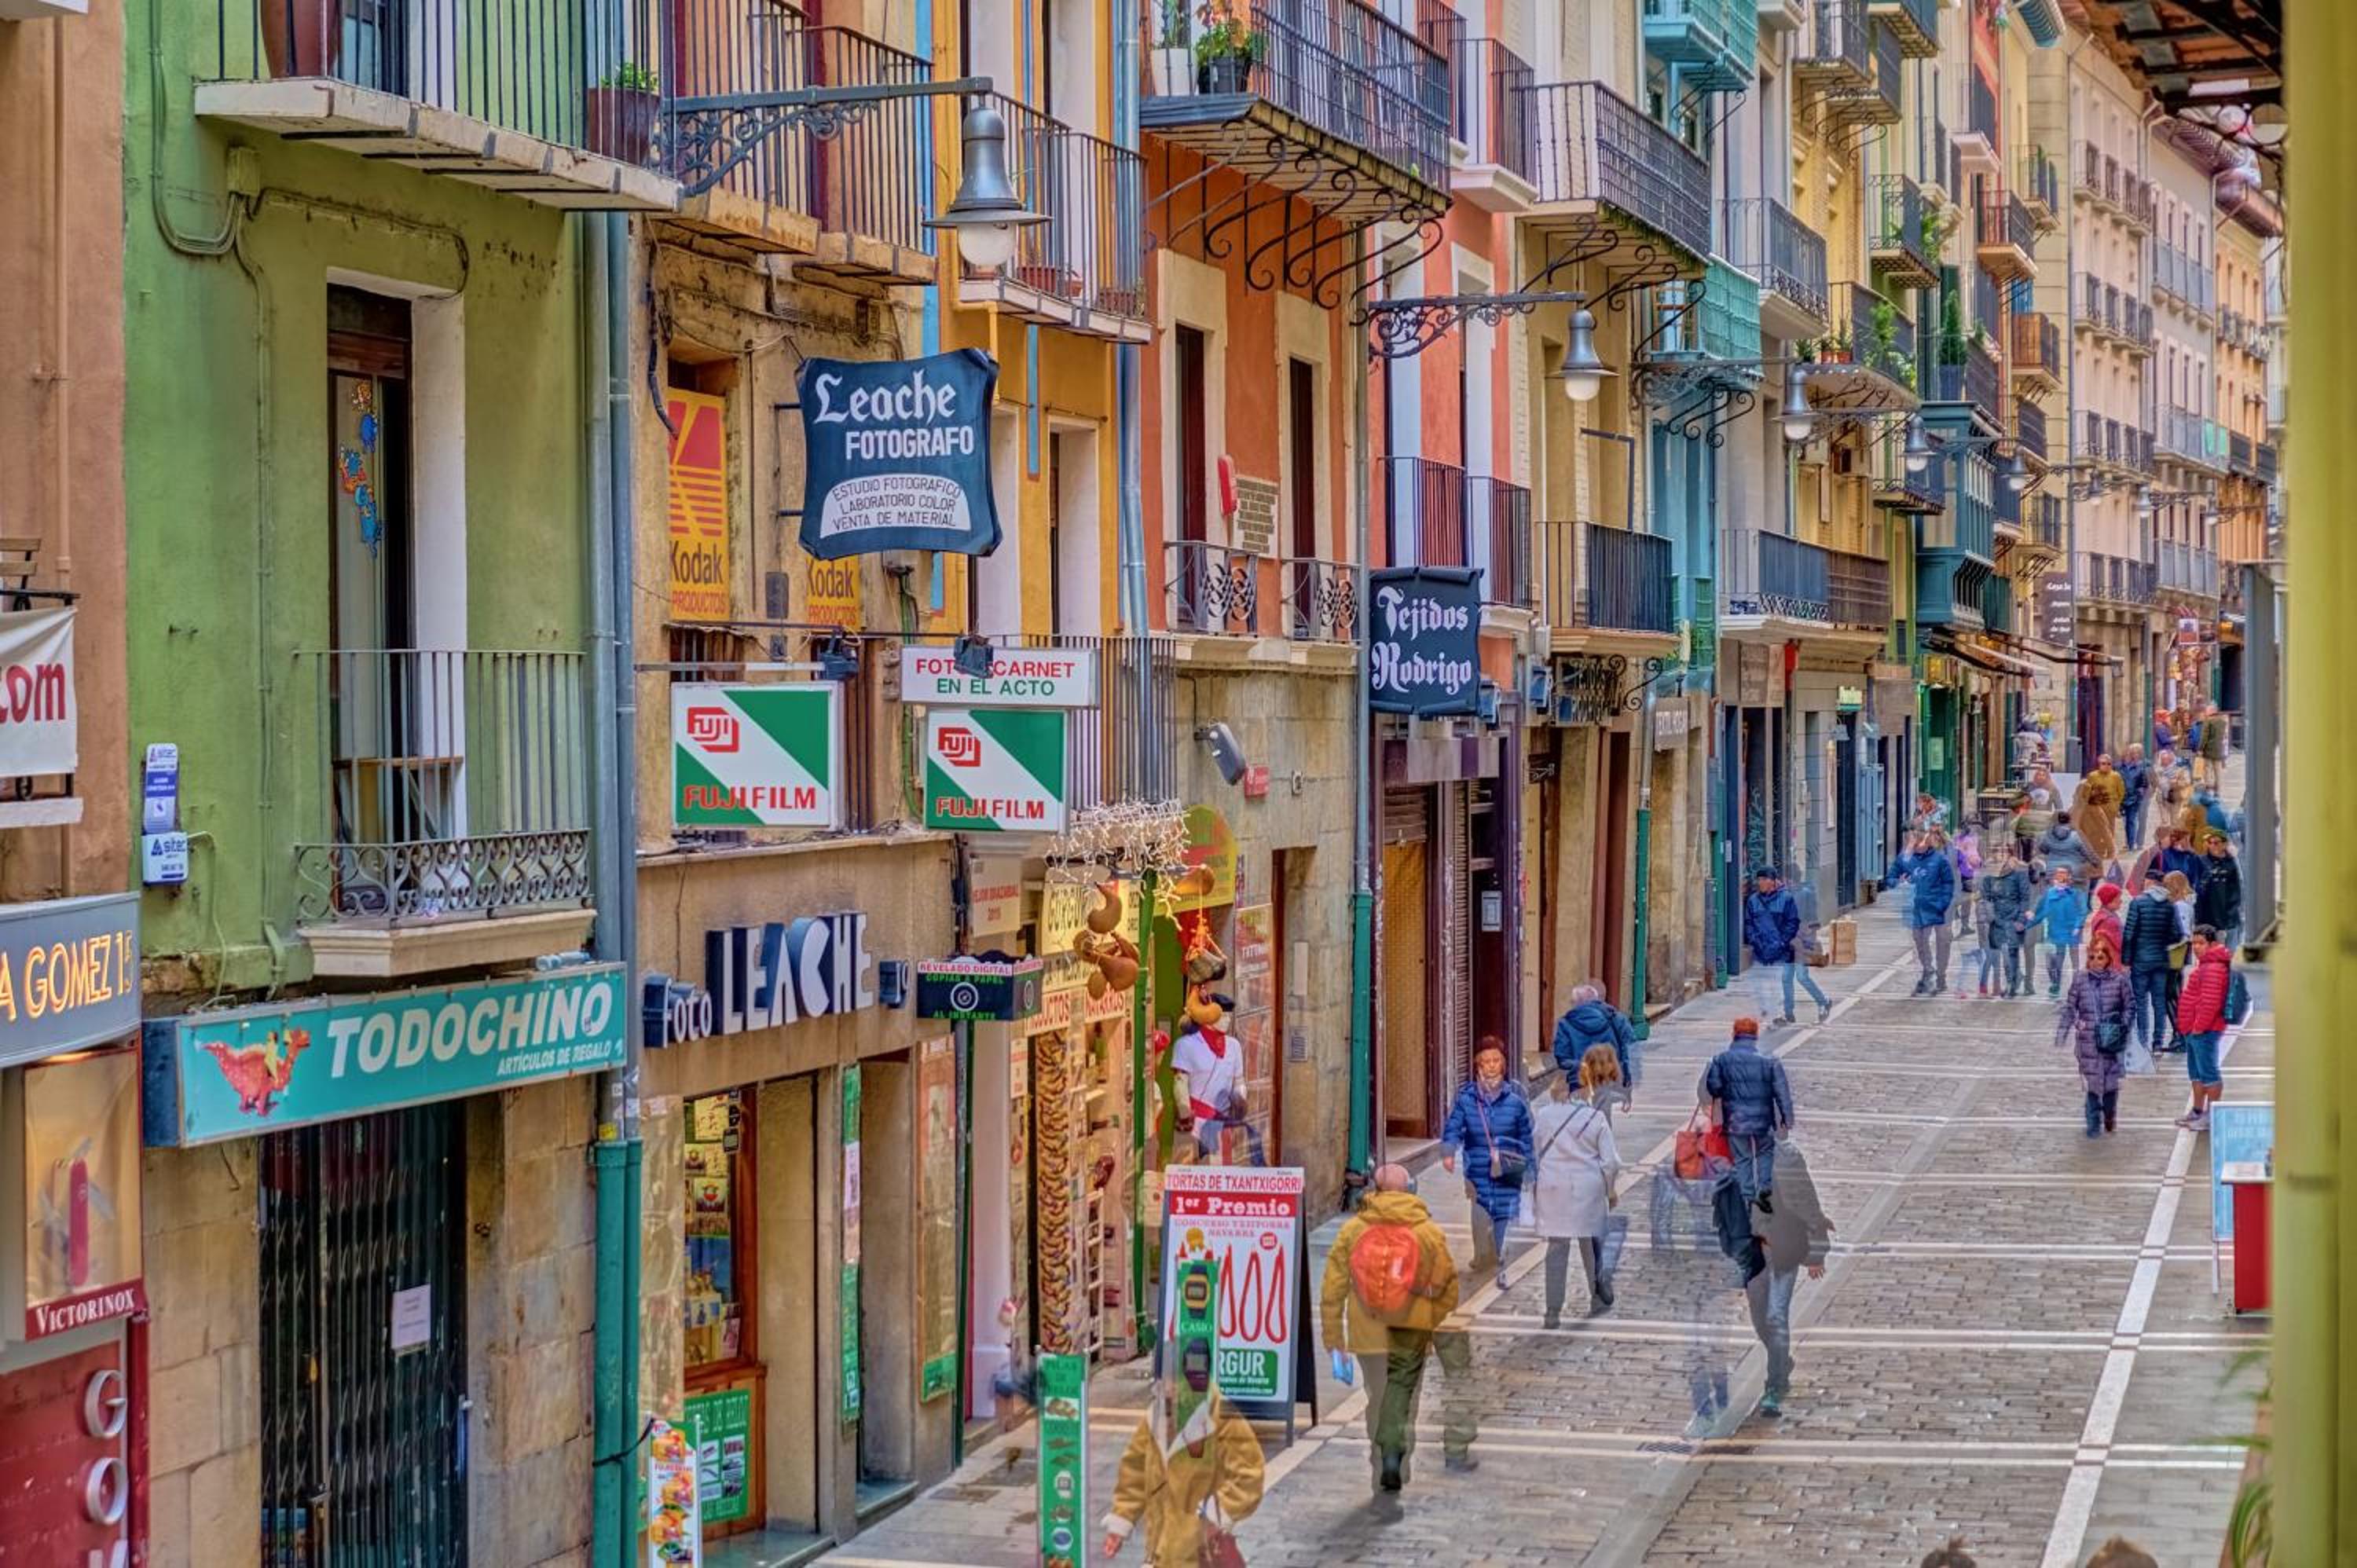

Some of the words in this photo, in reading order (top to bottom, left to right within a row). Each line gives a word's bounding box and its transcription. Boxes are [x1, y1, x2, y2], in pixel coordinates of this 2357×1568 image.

[812, 368, 956, 424] Leache
[845, 425, 974, 460] FOTOGRAFO
[833, 478, 881, 501] ESTUDIO
[884, 476, 960, 498] FOTOGRAFICO
[841, 493, 915, 515] LABORATORIO
[918, 494, 956, 512] COLOR
[832, 514, 871, 531] VENTA
[876, 512, 892, 525] DE
[897, 511, 956, 527] MATERIAL
[669, 540, 724, 584] Kodak
[672, 590, 726, 614] PRODUCTOS
[1377, 585, 1468, 641] Tejidos
[806, 605, 857, 626] PRODUCTOS
[993, 661, 1075, 678] CARNET
[1372, 641, 1472, 695] Rodrigo
[937, 678, 961, 694] EN
[970, 680, 992, 694] EL
[999, 680, 1055, 696] ACTO
[687, 707, 737, 749] FUJI
[938, 727, 978, 764] FUJI
[25, 934, 112, 1018] GOMEZ
[723, 914, 874, 1035] LEACHE
[920, 962, 970, 973] REVELADO
[973, 964, 1010, 975] DIGITAL
[926, 973, 960, 982] COPIAS
[973, 975, 1004, 984] PAPEL
[933, 1010, 944, 1019] AL
[949, 1011, 996, 1020] INSTANTE
[327, 981, 613, 1079] TODOCHINO
[497, 1048, 555, 1076] ARTÍCULOS
[557, 1046, 571, 1066] DE
[572, 1040, 612, 1063] REGALO
[1168, 1174, 1206, 1189] TORTAS
[1209, 1176, 1222, 1189] DE
[1226, 1175, 1302, 1192] TXANTXIGORRI
[1207, 1196, 1291, 1216] Premio
[1181, 1321, 1213, 1333] CASIO
[1219, 1350, 1266, 1376] RGUR
